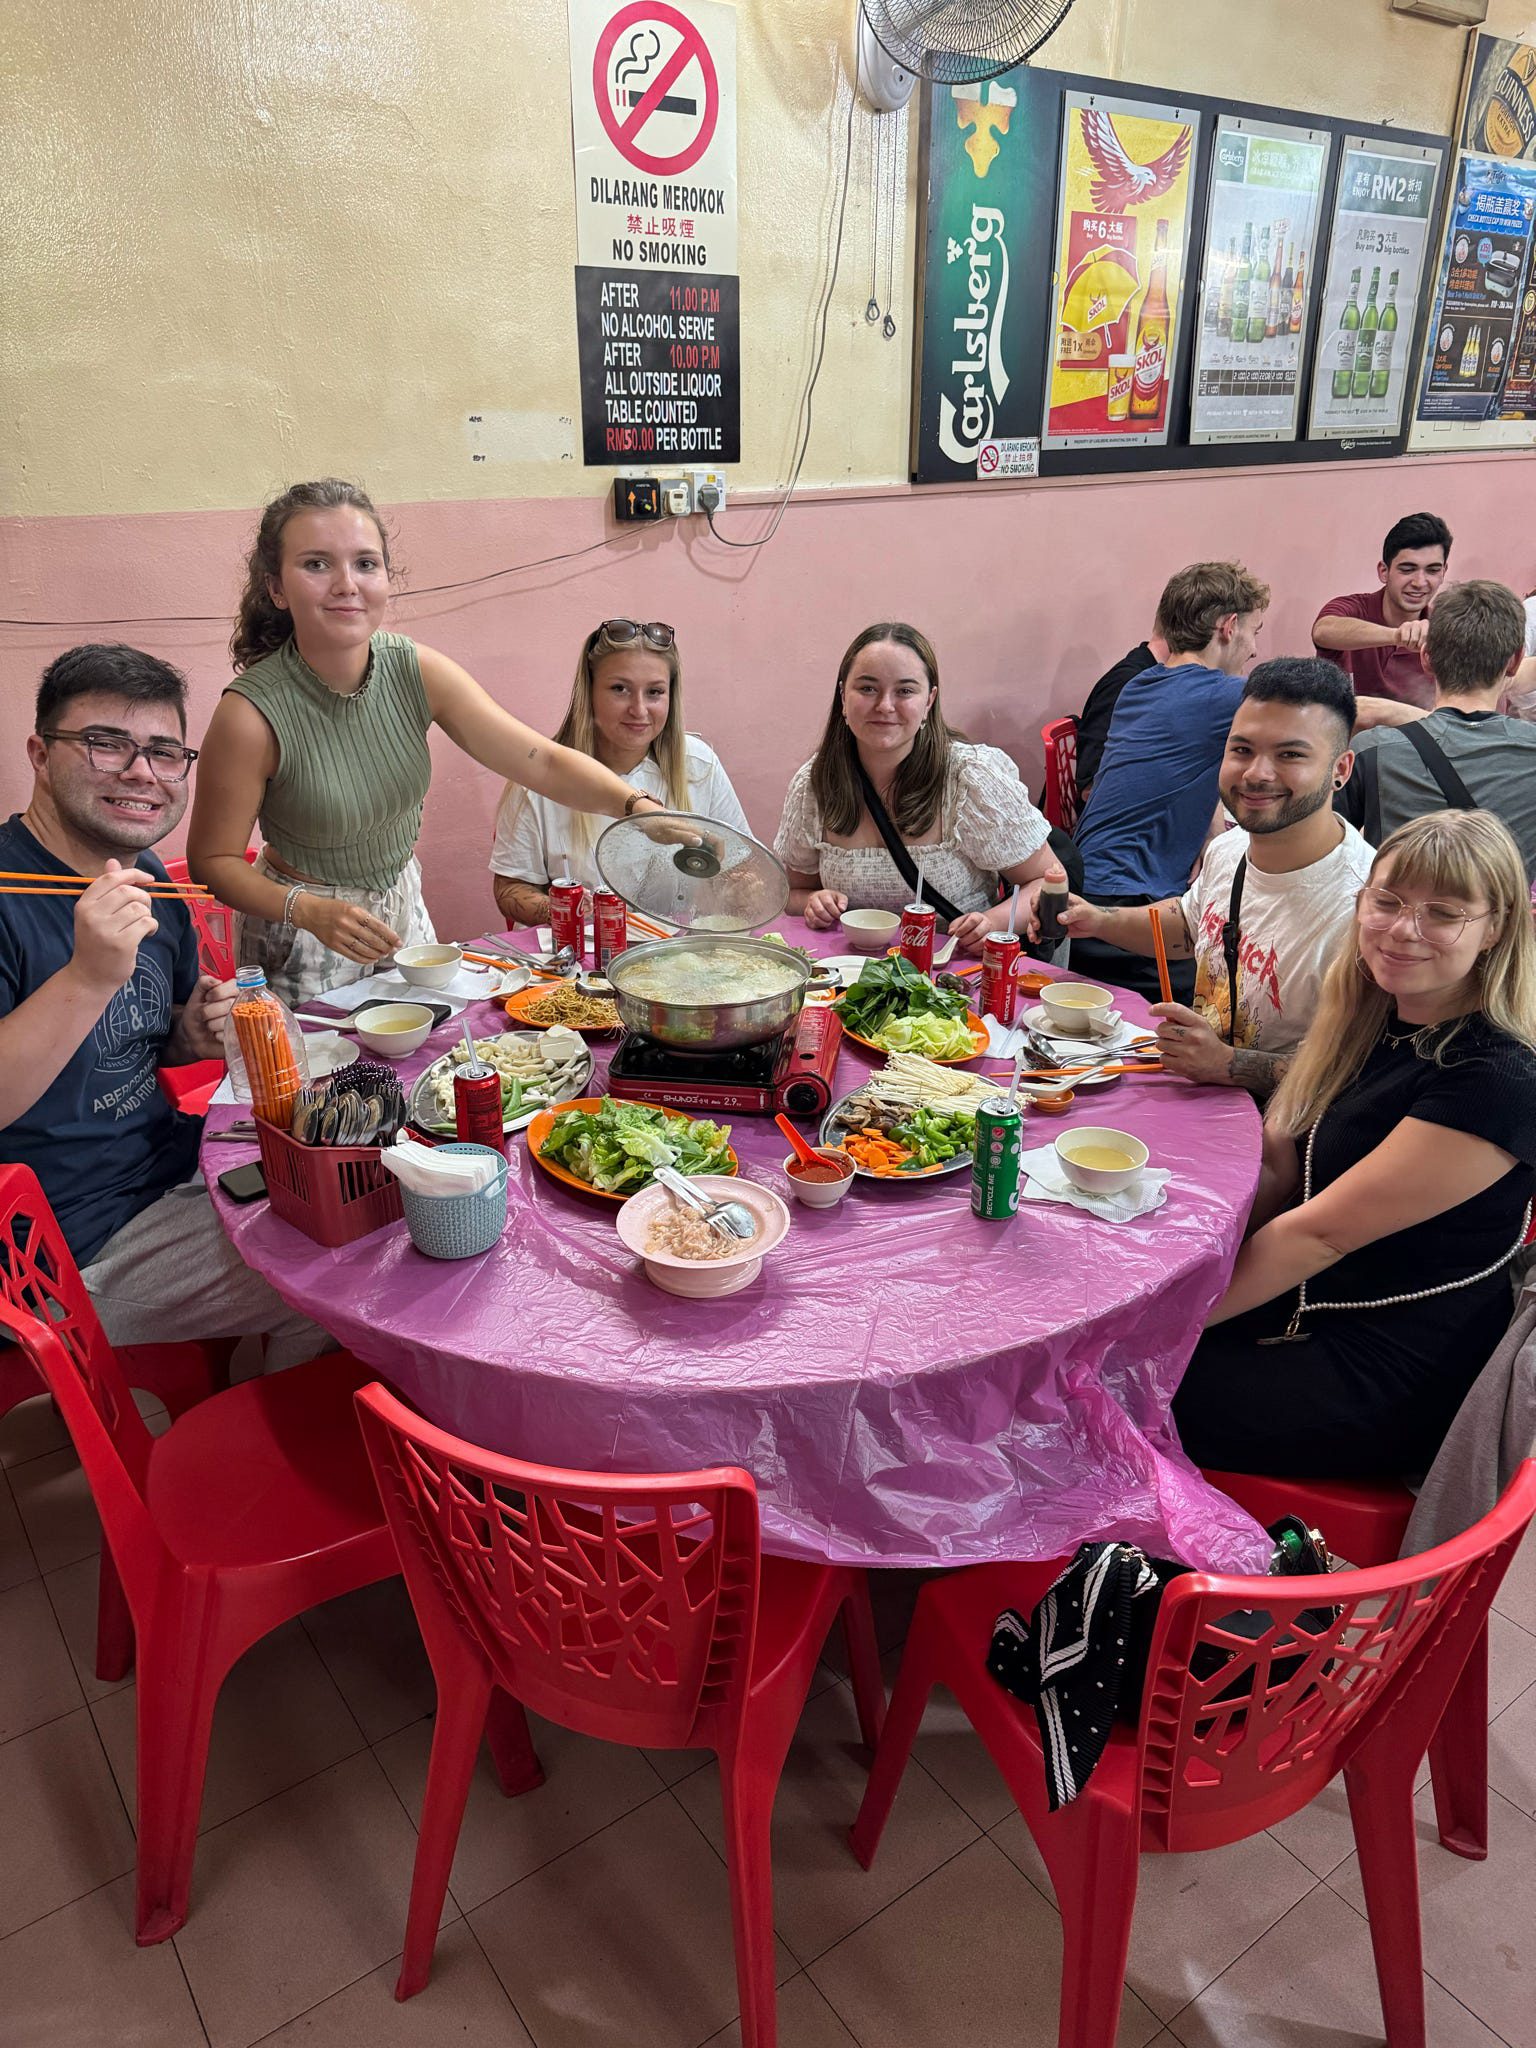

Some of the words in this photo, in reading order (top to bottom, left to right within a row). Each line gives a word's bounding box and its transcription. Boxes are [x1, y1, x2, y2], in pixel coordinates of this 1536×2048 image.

[1495, 69, 1534, 142] GUINNESS
[591, 177, 658, 209] DILARANG
[663, 184, 724, 214] MEROKOK
[1371, 174, 1407, 202] RM2
[1407, 194, 1419, 202] OFF
[627, 214, 695, 238] 禁止吸煙
[1098, 221, 1106, 238] 6
[612, 239, 633, 261] NO
[639, 242, 706, 265] SMOKING
[1355, 242, 1365, 252] Buy
[1366, 244, 1375, 252] any
[1393, 246, 1410, 255] bottles
[1376, 233, 1384, 253] 3
[601, 282, 639, 308] AFTER
[670, 286, 698, 312] 11.00
[701, 288, 720, 312] P.M
[1089, 298, 1105, 319] SKOL
[602, 313, 619, 337] NO
[621, 314, 676, 339] ALCOHOL
[679, 317, 714, 340] SERVE
[939, 203, 1010, 464] Carlsberg
[604, 343, 641, 366] AFTER
[670, 345, 698, 368] 10.00
[701, 345, 720, 369] P.M
[1136, 348, 1162, 371] SKOL
[605, 372, 627, 395] ALL
[630, 372, 677, 396] OUTSIDE
[681, 373, 721, 397] LIQUOR
[1110, 379, 1130, 399] SKOL
[606, 400, 641, 423] TABLE
[645, 400, 697, 424] COUNTED
[607, 428, 654, 451] RM50.00
[656, 428, 678, 450] PER
[681, 428, 721, 450] BOTTLE
[1001, 464, 1009, 474] NO
[1010, 464, 1034, 473] SMOKING
[123, 980, 138, 999] A
[130, 1005, 144, 1031] &
[115, 1096, 141, 1121] AND
[135, 1073, 158, 1101] FITCH
[724, 1097, 736, 1106] 2.9
[989, 1174, 995, 1184] ME
